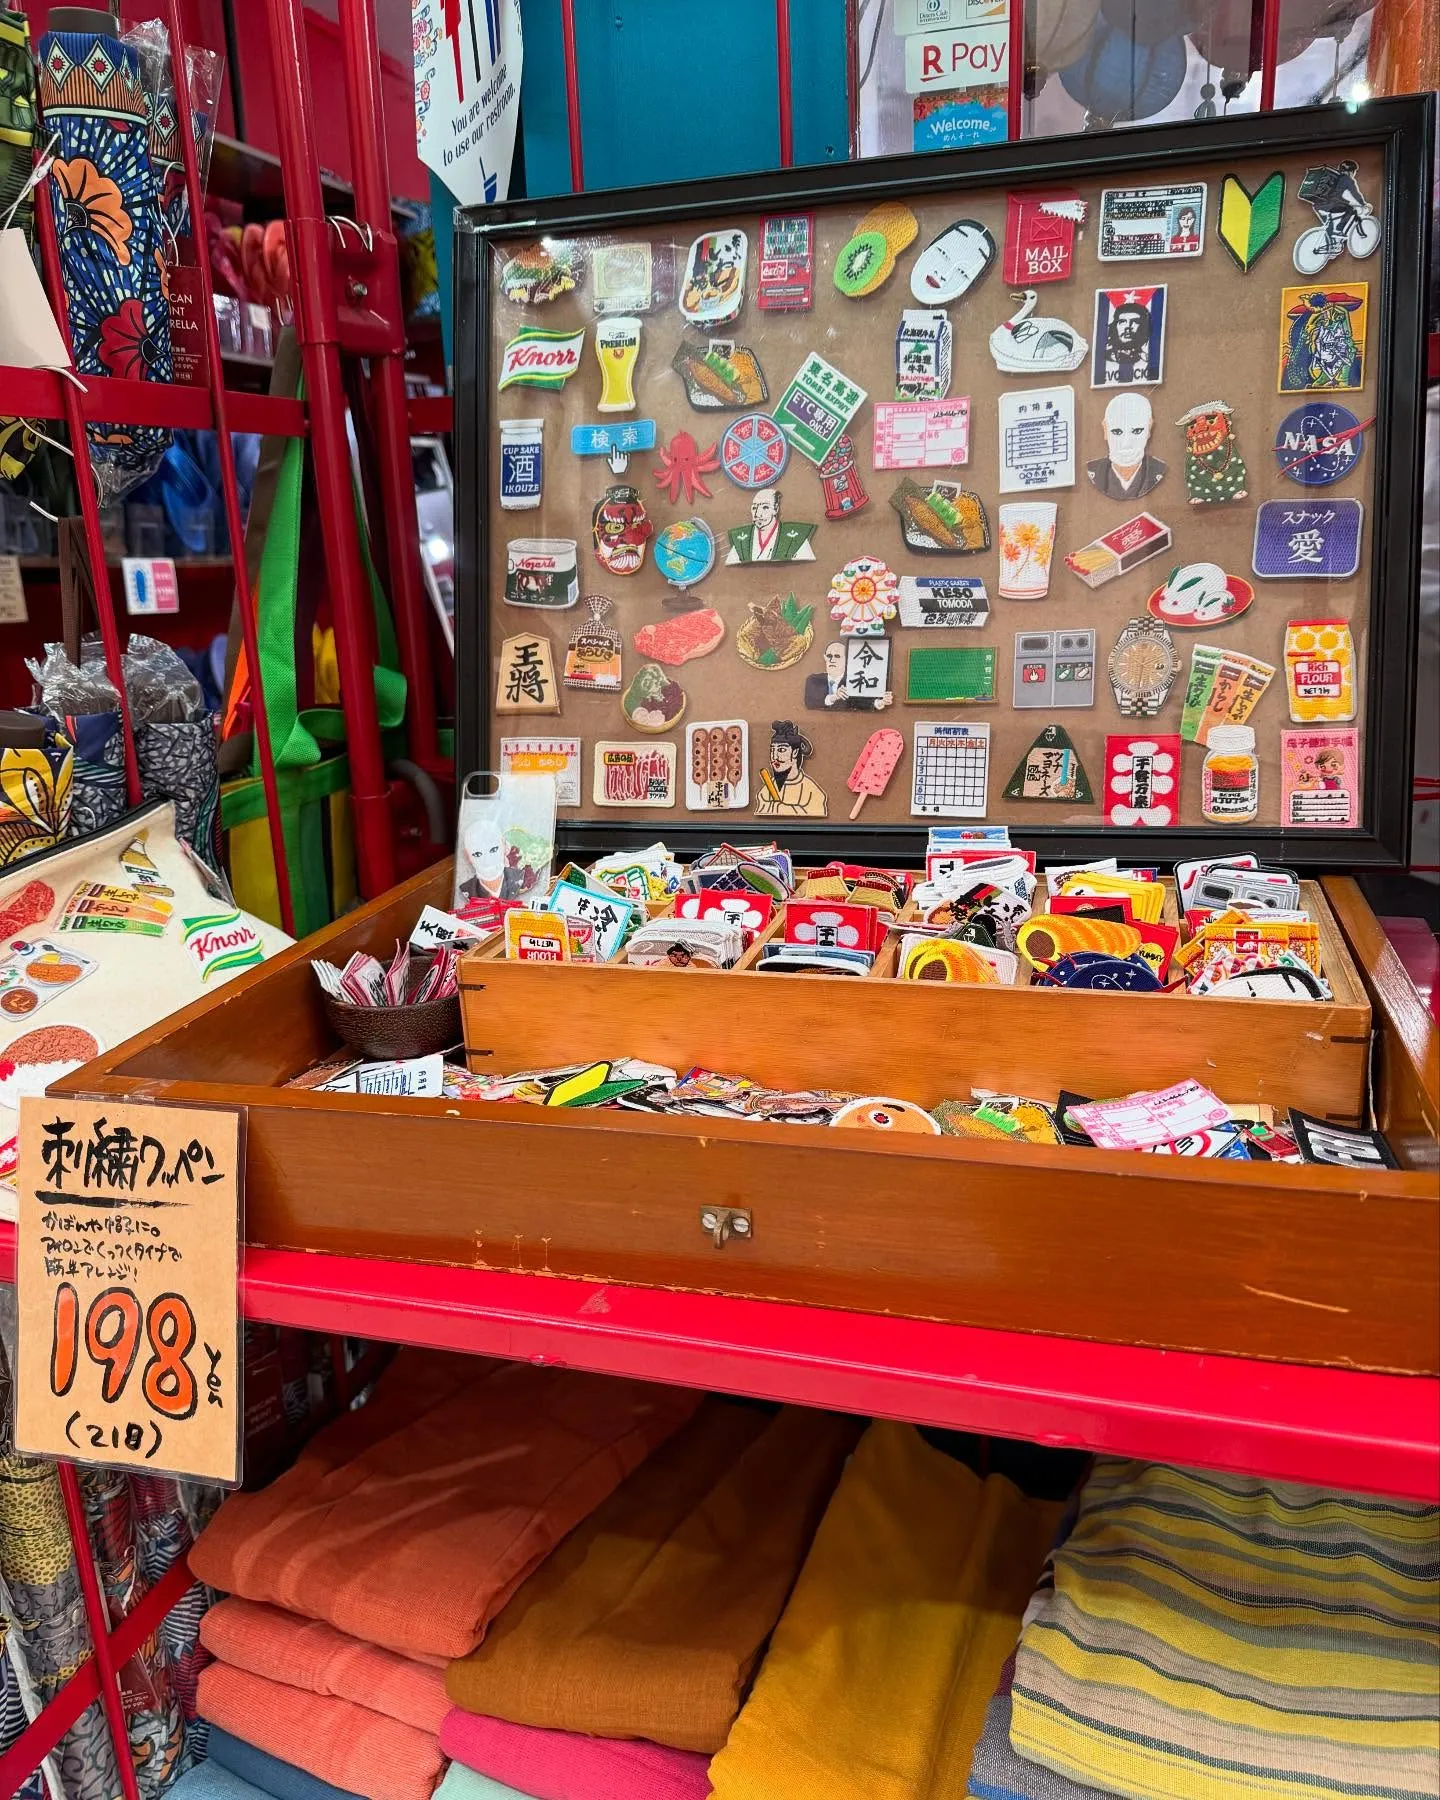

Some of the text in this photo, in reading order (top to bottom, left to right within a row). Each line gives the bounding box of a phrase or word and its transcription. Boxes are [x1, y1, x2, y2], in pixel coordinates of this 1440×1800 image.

[952, 42, 997, 73] Pay
[451, 64, 507, 136] You are welcome
[443, 82, 516, 166] to use our restroom.
[930, 118, 991, 137] Welcome
[1025, 245, 1068, 263] MAIL
[1028, 259, 1062, 275] BOX
[508, 345, 578, 373] Knorr
[907, 364, 927, 374] 牛乳
[807, 360, 860, 406] 東名高速
[792, 391, 837, 431] ETC専用
[591, 427, 638, 448] 検索
[809, 420, 829, 437] ONLY
[503, 446, 540, 455] CUP SAKE
[1284, 431, 1356, 456] NASA
[509, 455, 535, 483] 酒
[505, 484, 539, 494] IKOUZE
[1282, 510, 1336, 525] スナック
[1288, 528, 1325, 564] 愛
[931, 587, 974, 599] KESO
[937, 599, 973, 609] TOMODA
[580, 637, 611, 646] スペシャル
[849, 641, 884, 694] 令和
[1308, 662, 1329, 672] Rich
[1300, 673, 1334, 684] FLOUR
[977, 740, 985, 748] 土
[1053, 752, 1064, 773] ツナ
[1039, 752, 1052, 796] マヨネーズ
[1133, 758, 1150, 808] 千客万来
[190, 926, 256, 961] Knorr
[41, 1116, 226, 1191] 刺繍ワッペン
[50, 1281, 198, 1421] 198
